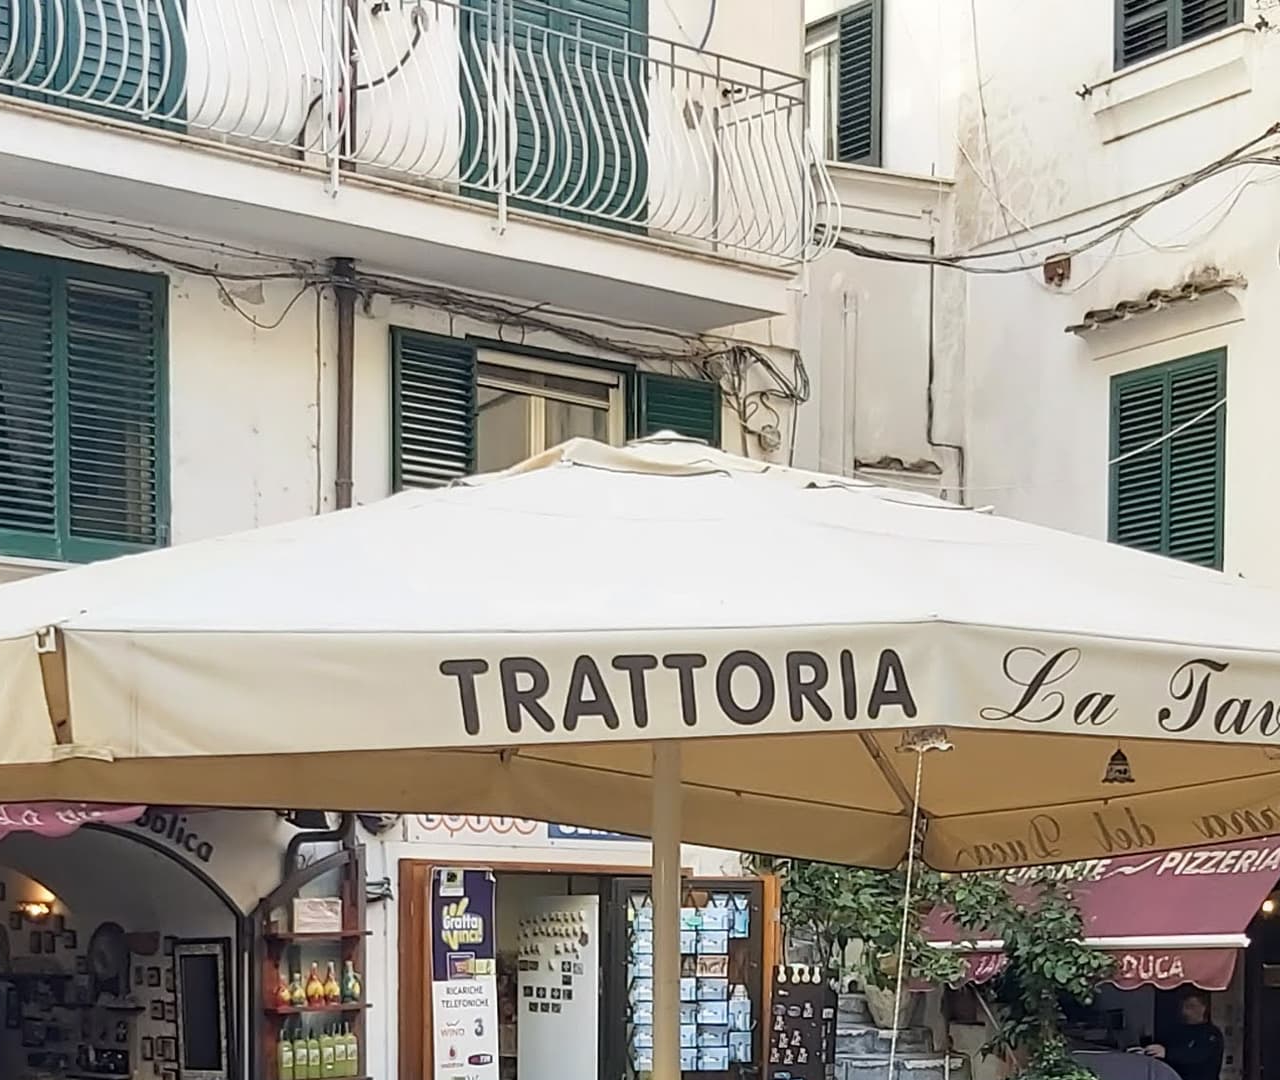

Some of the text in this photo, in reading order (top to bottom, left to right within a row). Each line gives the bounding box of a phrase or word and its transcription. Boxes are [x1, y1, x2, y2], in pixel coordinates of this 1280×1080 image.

[439, 648, 918, 735] TRATTORIA
[979, 646, 1119, 725] La
[1122, 954, 1185, 980] DUCA
